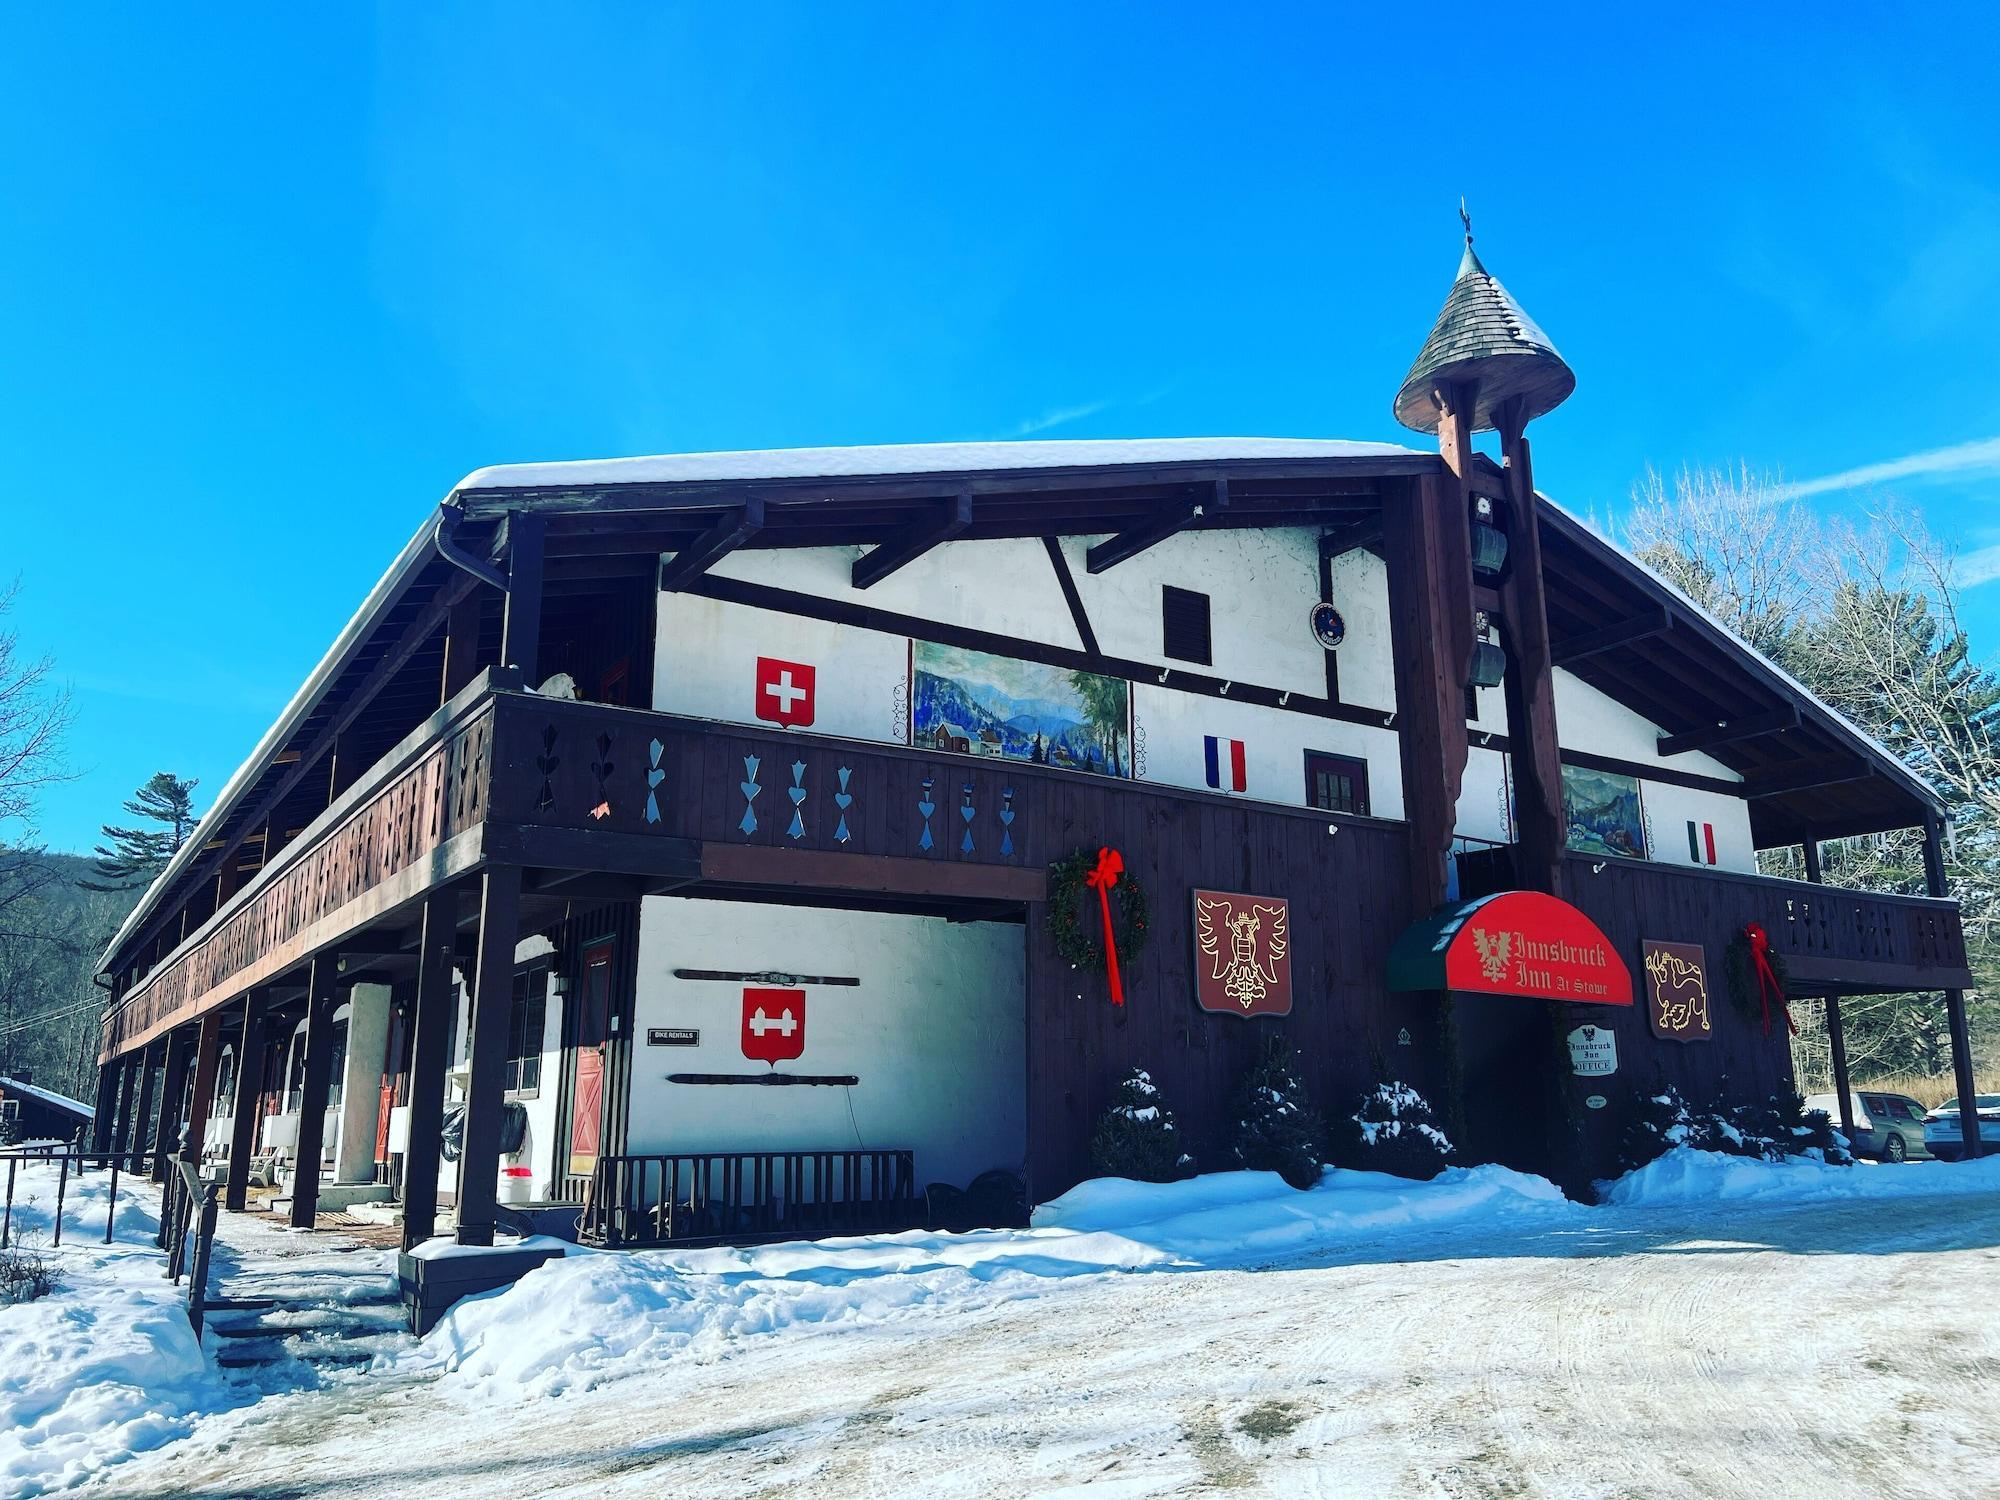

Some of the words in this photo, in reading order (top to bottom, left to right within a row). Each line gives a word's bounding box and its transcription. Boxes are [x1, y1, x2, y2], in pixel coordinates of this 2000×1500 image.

[1513, 931, 1606, 967] Innsbruck
[1515, 960, 1551, 989] Inn
[1556, 976, 1570, 994] At
[1573, 978, 1608, 995] Stowe
[1575, 1061, 1610, 1071] OFFICE
